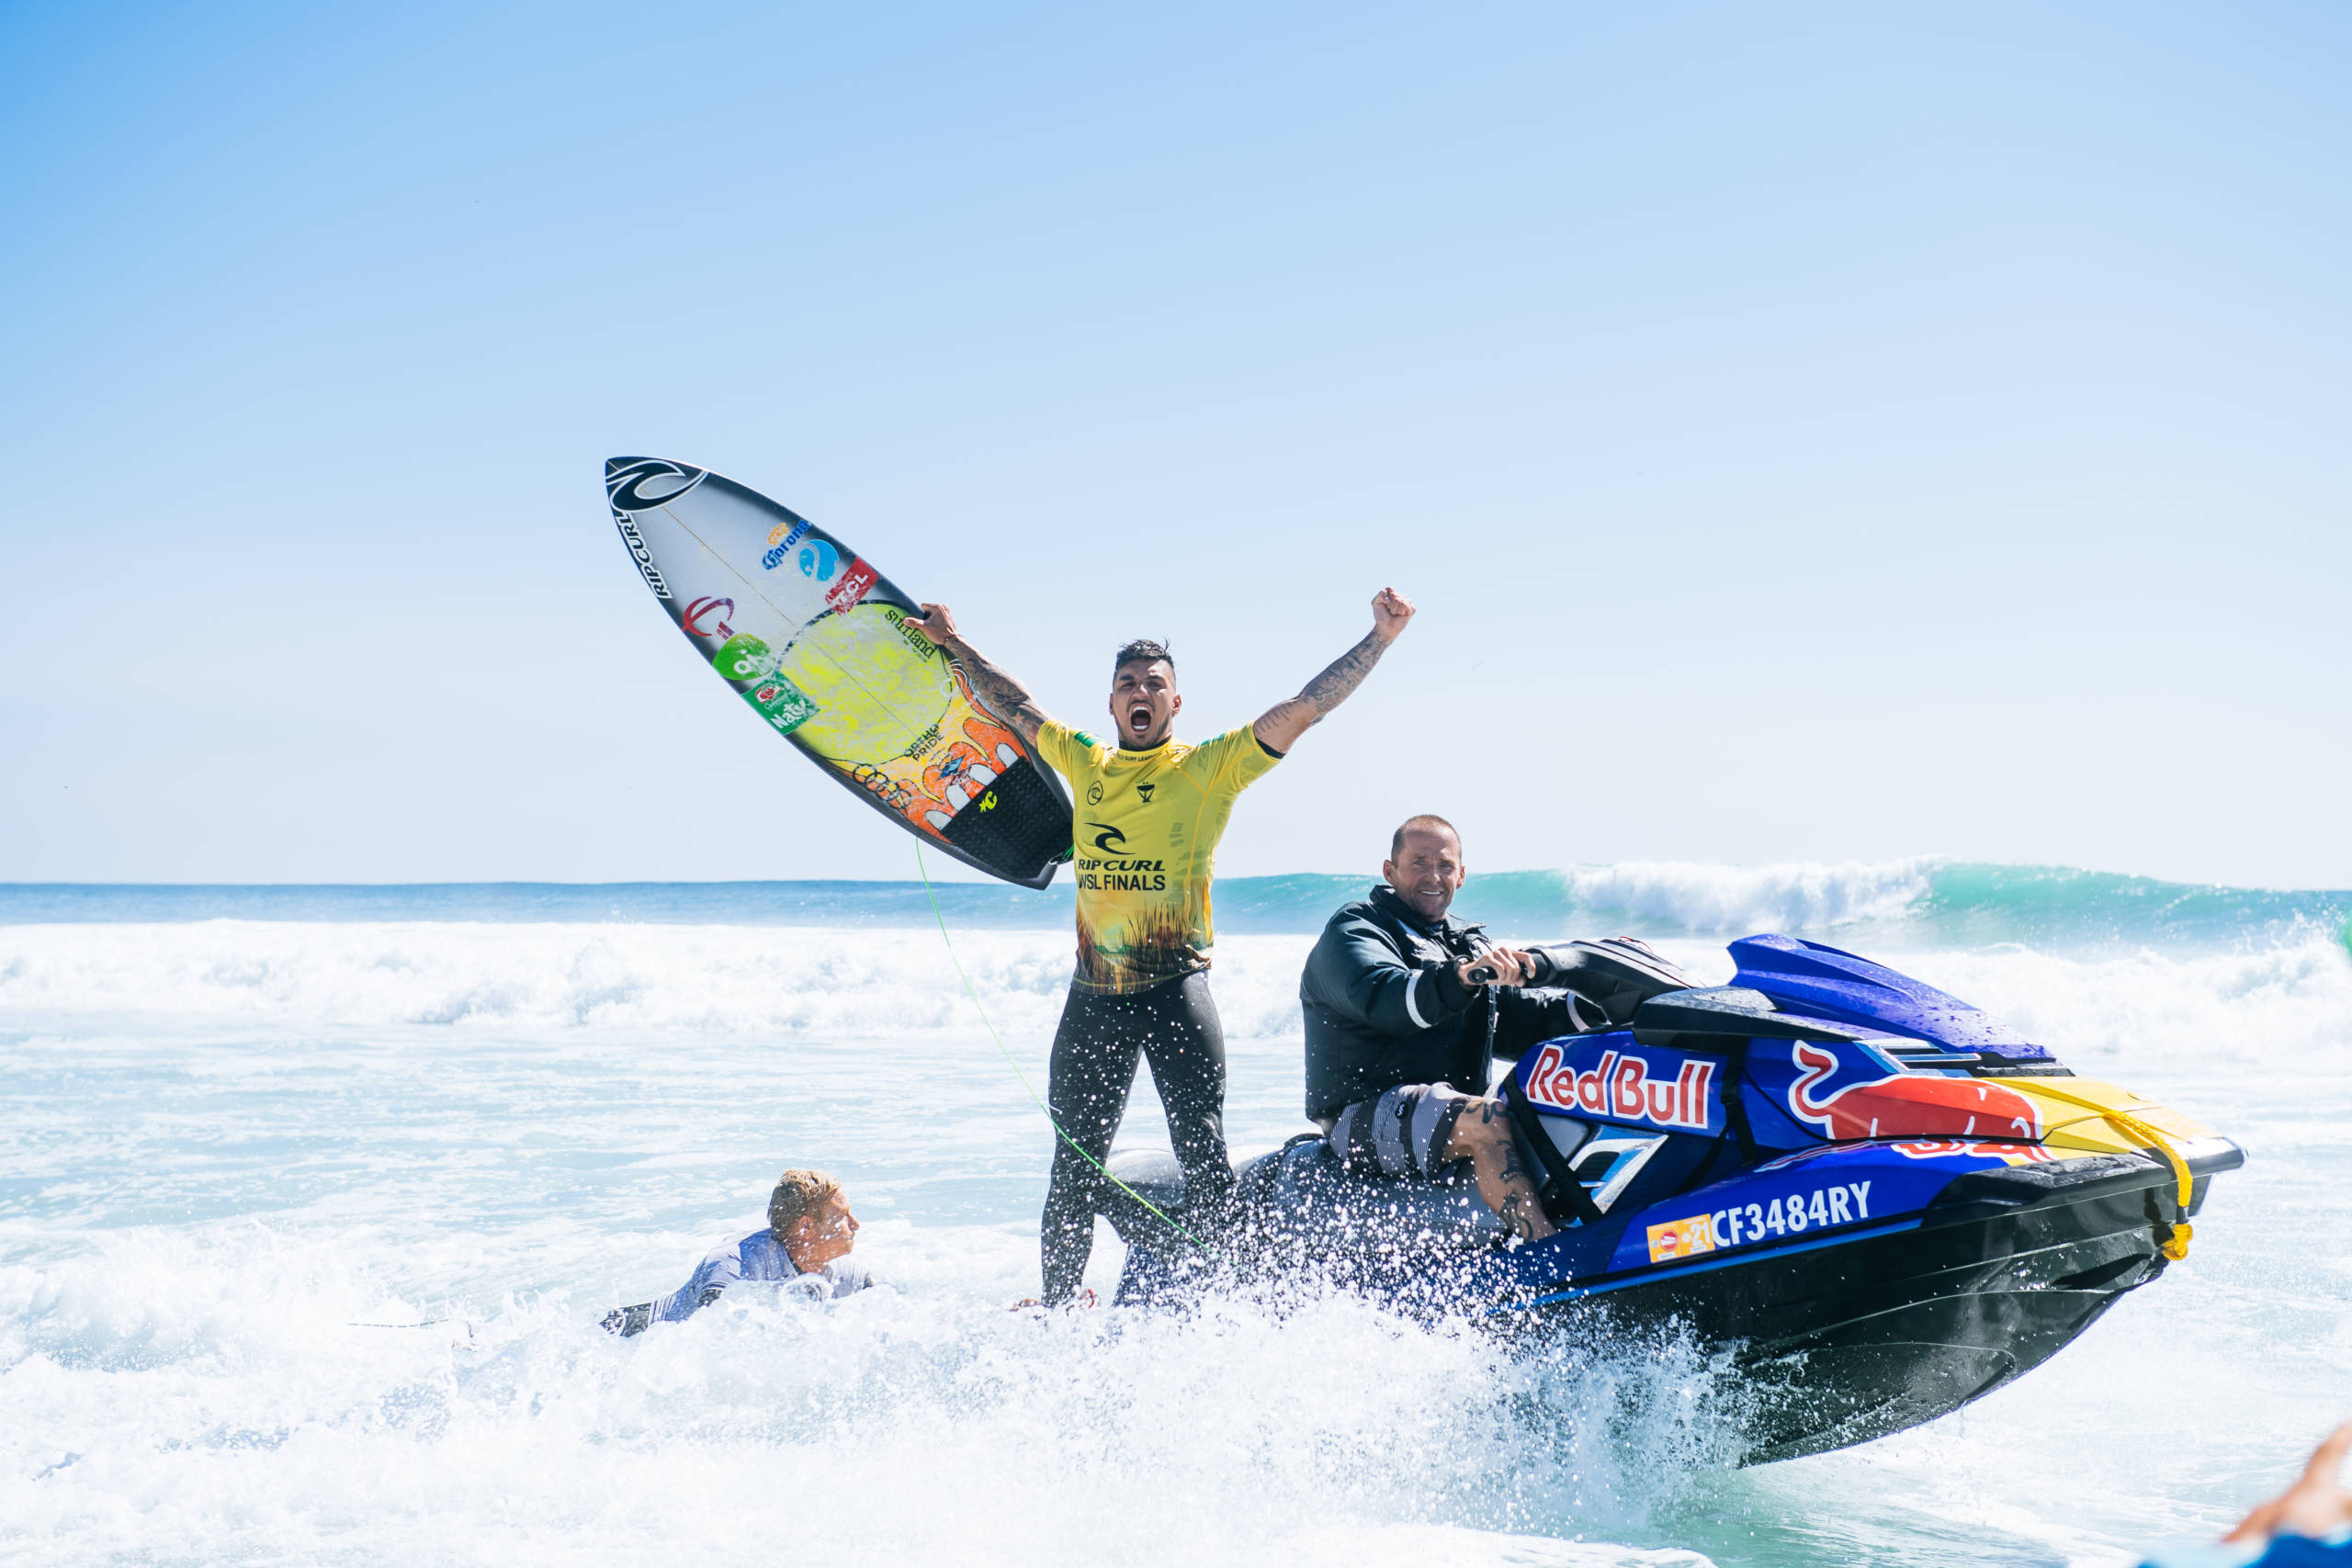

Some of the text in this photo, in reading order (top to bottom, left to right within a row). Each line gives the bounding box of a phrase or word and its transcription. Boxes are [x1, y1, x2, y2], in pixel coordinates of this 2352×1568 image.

[617, 513, 671, 597] RIP CURL
[762, 519, 811, 570] Corona
[830, 574, 868, 607] TCL
[912, 731, 944, 761] PRIDE
[1079, 858, 1166, 872] RIP CURL
[1103, 874, 1165, 891] FINALS
[1527, 1044, 1715, 1128] Red Bull
[1711, 1180, 1871, 1247] CF3484RY
[1690, 1221, 1712, 1247] 21
